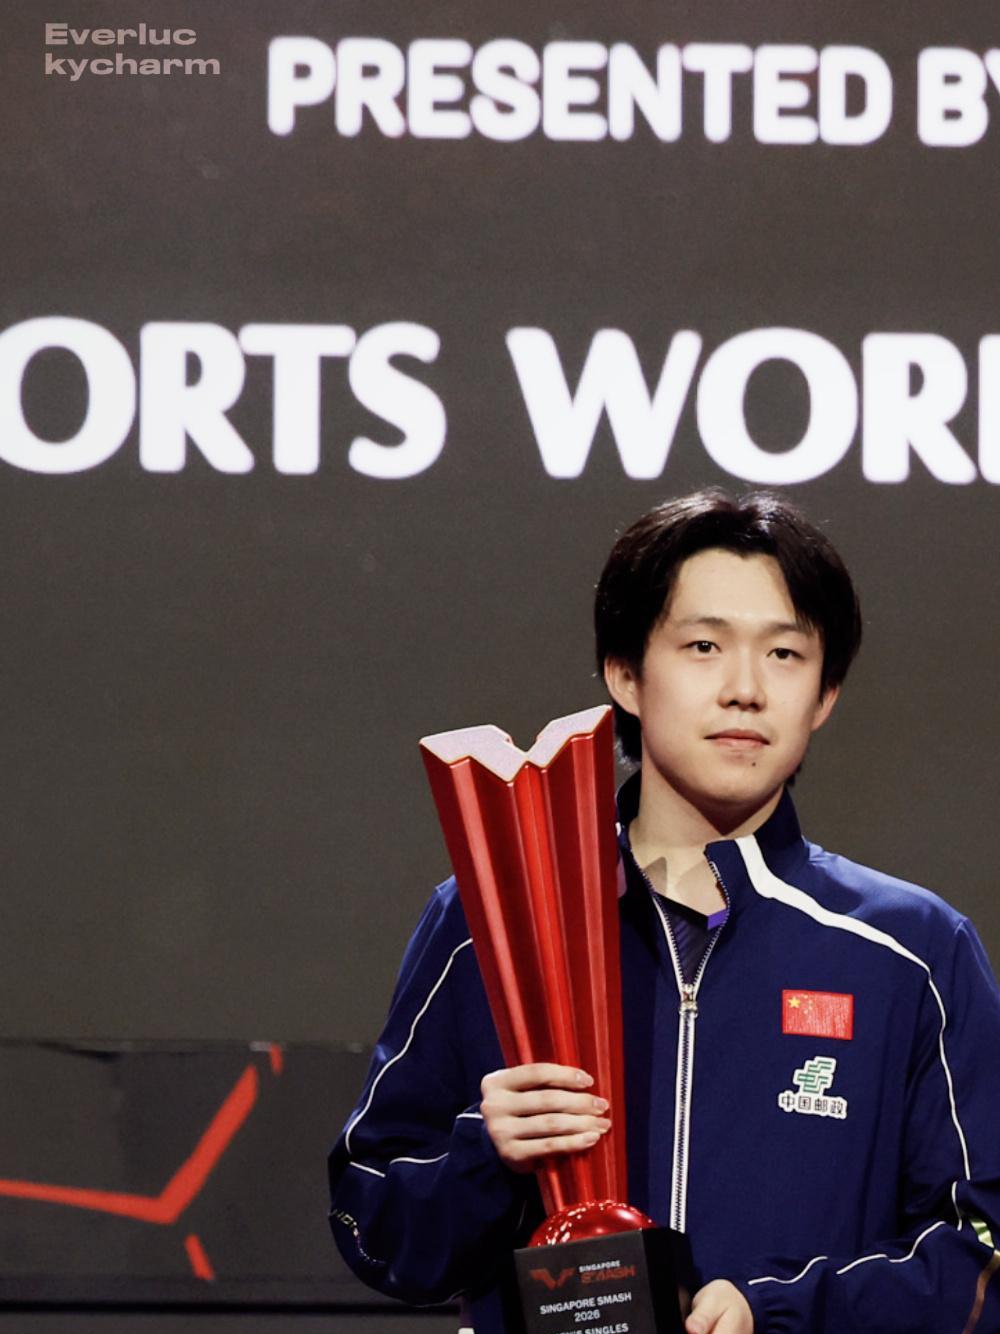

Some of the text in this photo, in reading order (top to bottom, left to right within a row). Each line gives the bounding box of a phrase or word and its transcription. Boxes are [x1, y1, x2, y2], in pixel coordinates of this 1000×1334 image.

[267, 36, 893, 146] PRESENTED
[780, 1093, 845, 1116] 中国邮政
[579, 1260, 620, 1273] SINGAPORE
[540, 1292, 632, 1315] SINGAPORE SMASH
[574, 1309, 600, 1322] 2026
